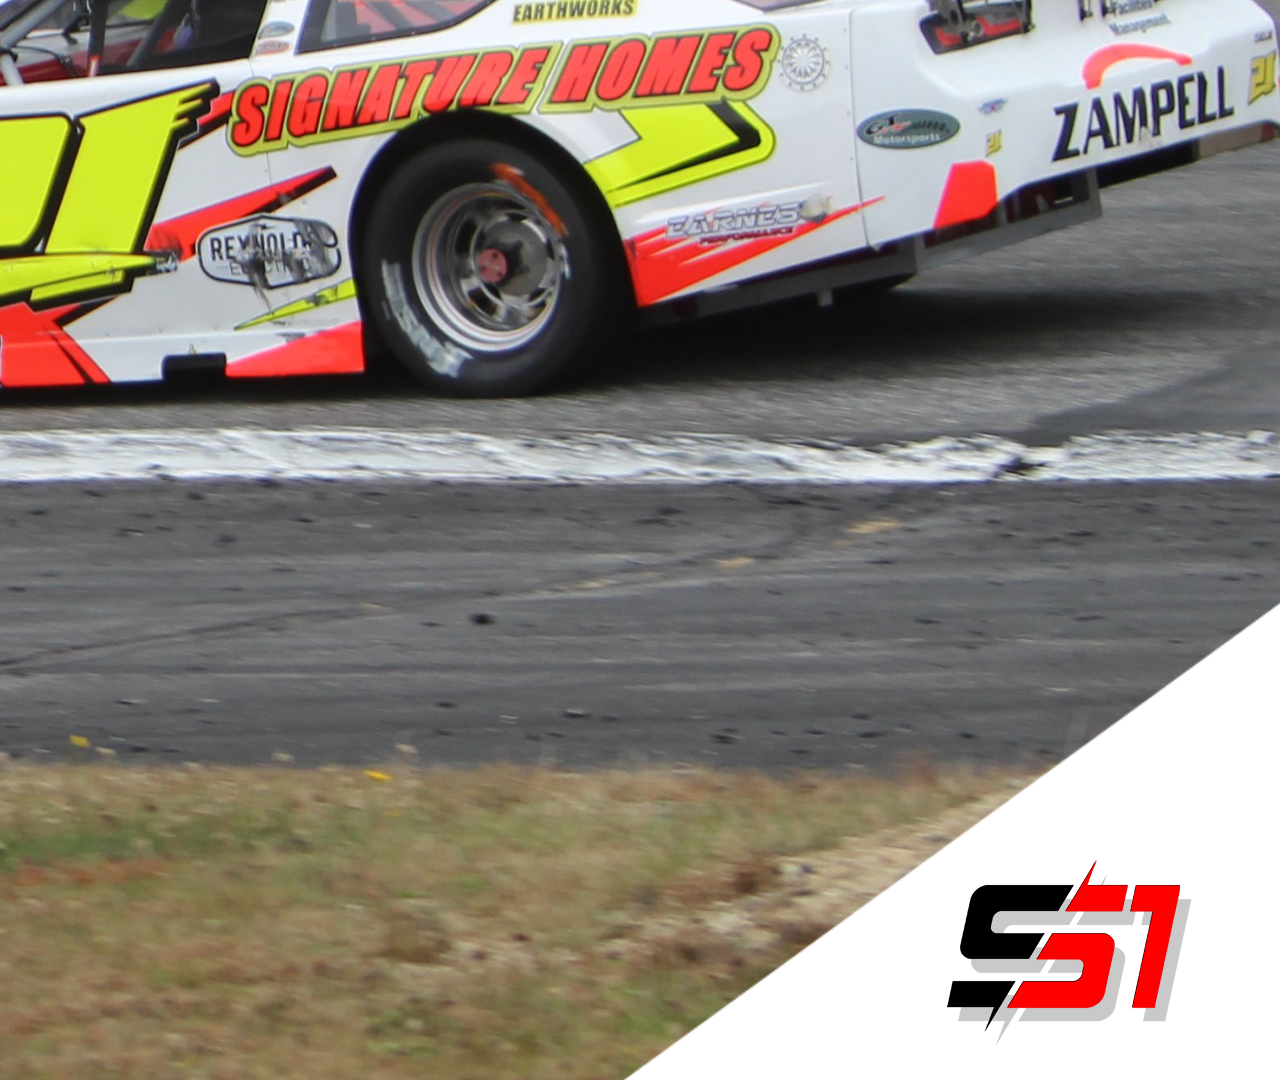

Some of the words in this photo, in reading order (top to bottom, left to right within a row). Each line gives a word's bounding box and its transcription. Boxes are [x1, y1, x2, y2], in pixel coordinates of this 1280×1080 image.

[228, 45, 549, 147] SIGNATURE
[550, 28, 768, 104] HOMES
[1051, 65, 1235, 163] ZAMPELL
[873, 132, 940, 145] Motorsports
[210, 231, 324, 262] REYNOLD
